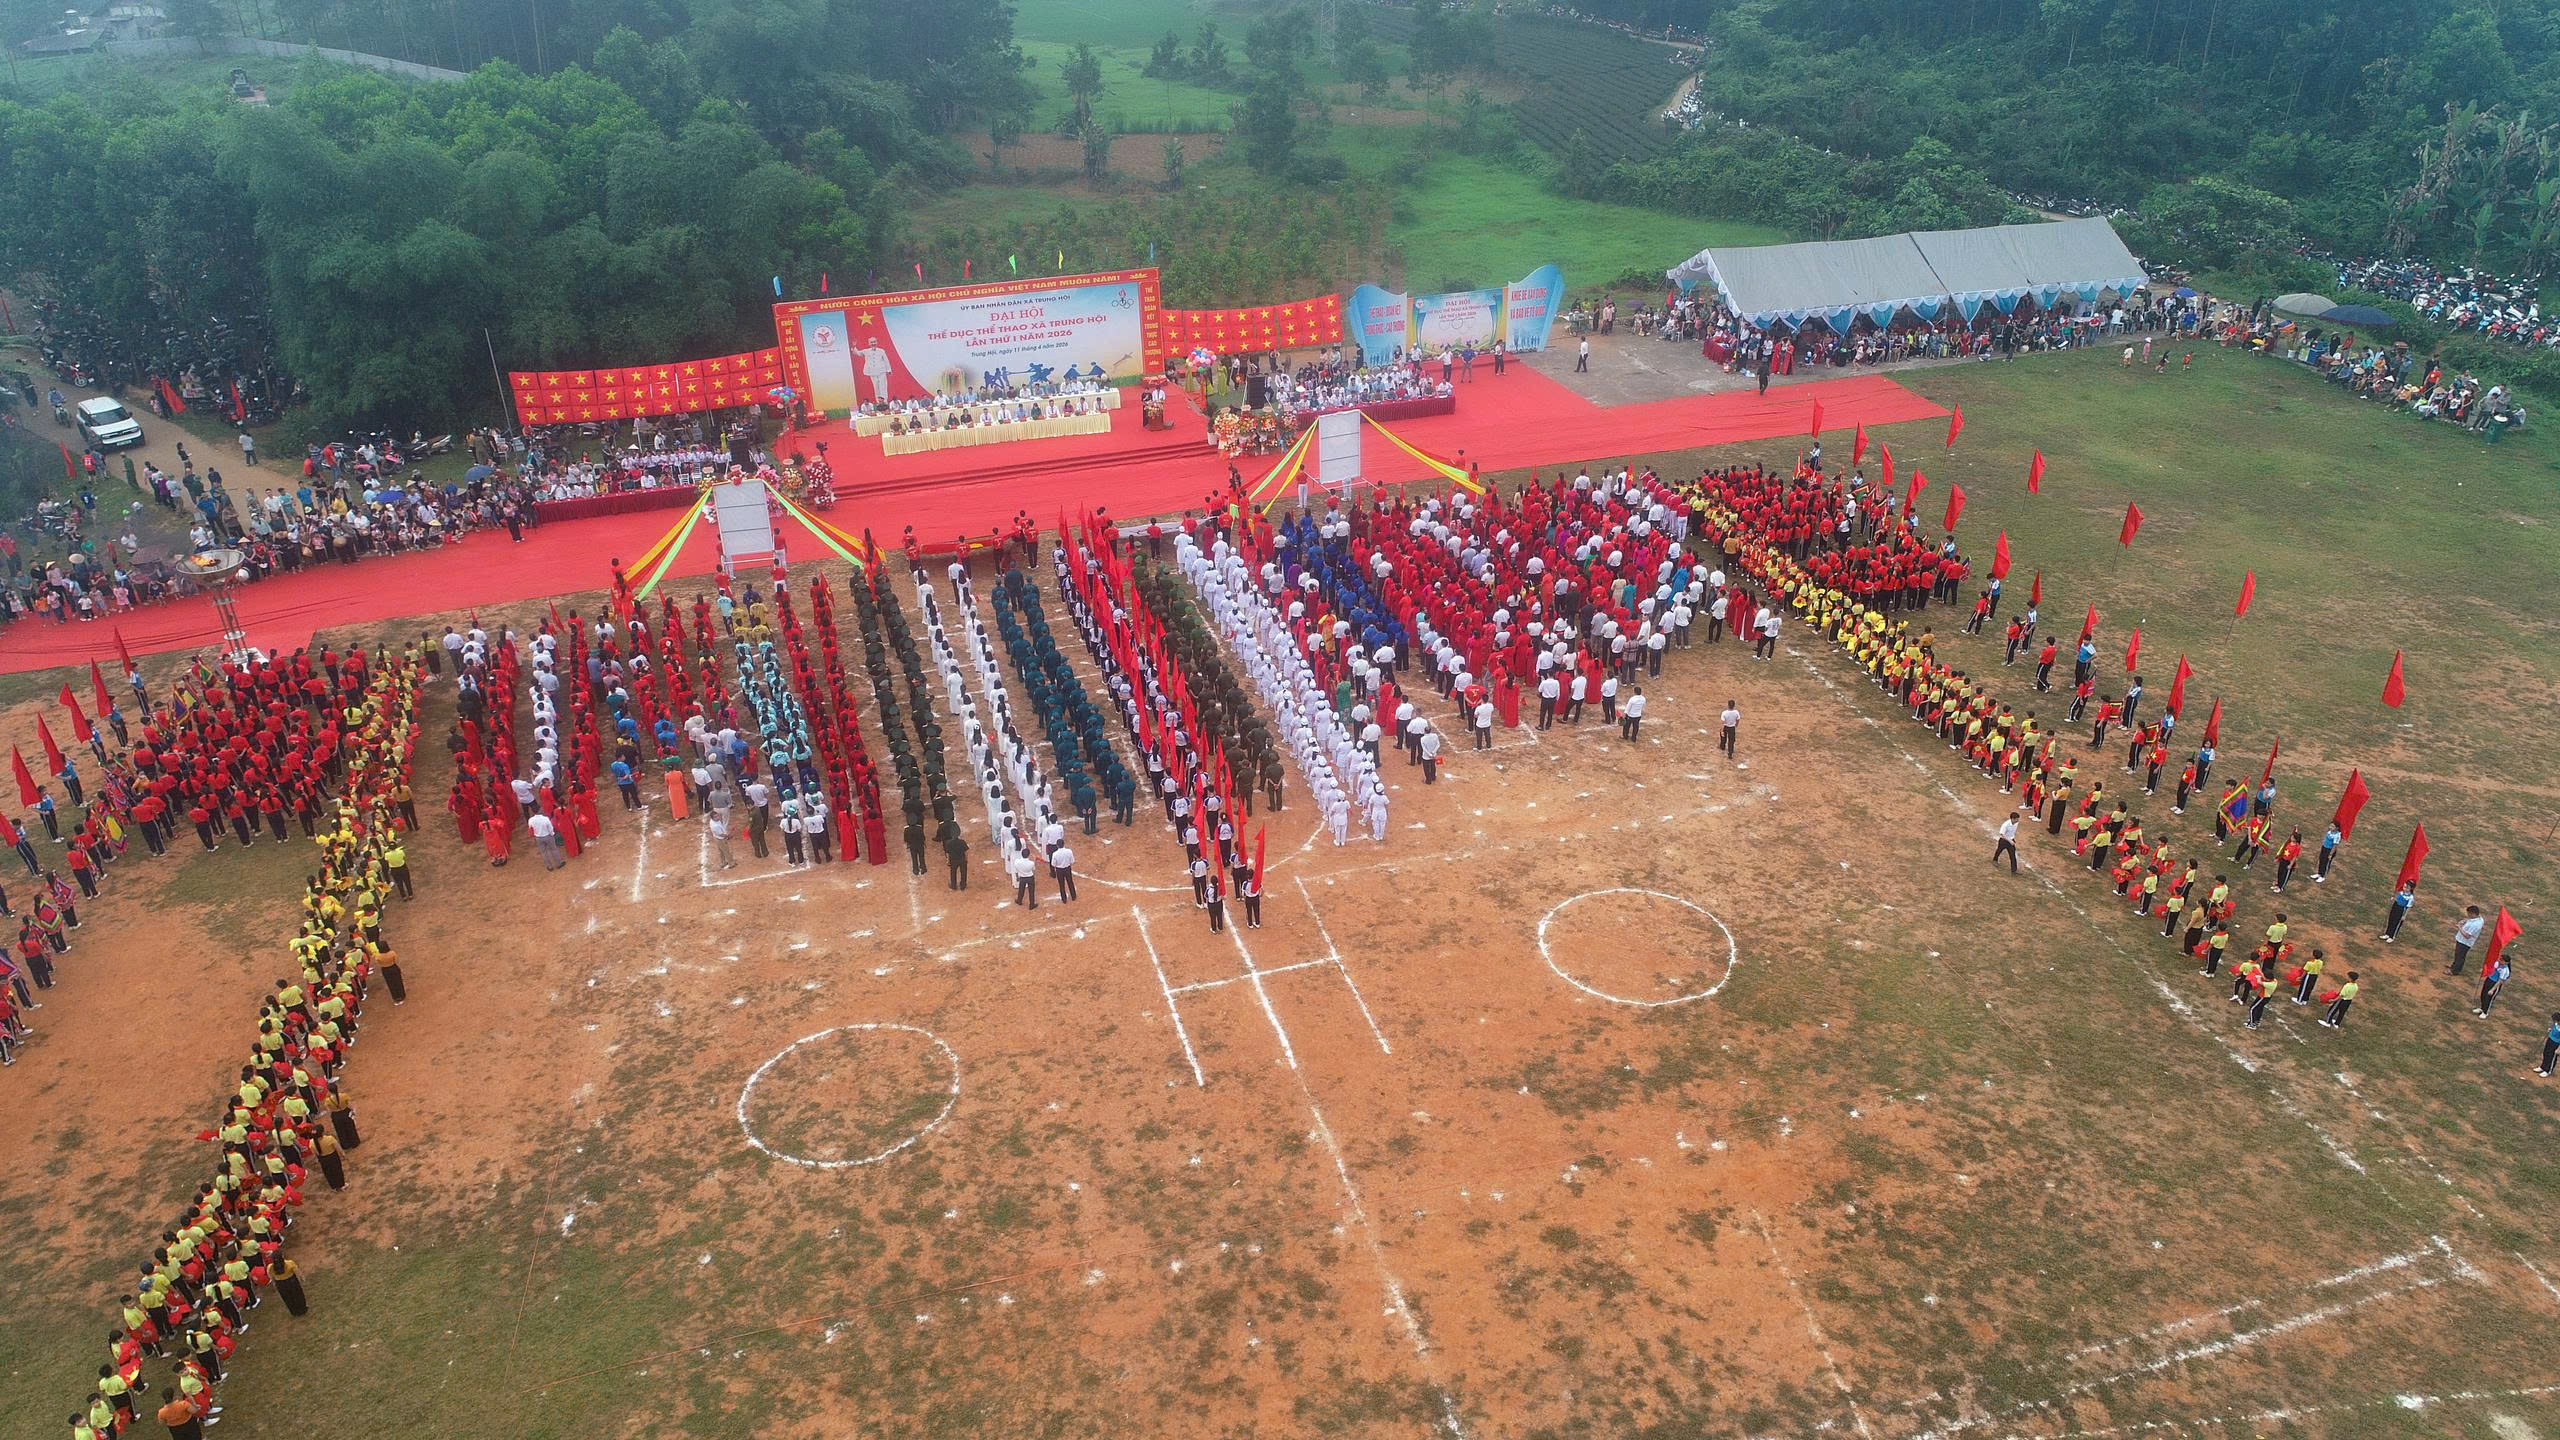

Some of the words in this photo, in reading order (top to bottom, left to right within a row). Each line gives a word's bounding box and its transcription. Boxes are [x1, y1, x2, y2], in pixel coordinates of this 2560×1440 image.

[820, 300, 850, 309] NƯỚC
[853, 298, 884, 307] CỘNG
[928, 292, 946, 300] HỘI
[949, 289, 970, 298] CHỦ
[973, 286, 1005, 295] NGHĨA
[1093, 275, 1120, 283] NĂM!
[990, 311, 1014, 322] ĐẠI
[1020, 306, 1044, 319] HỘI
[928, 330, 947, 340] THỂ
[950, 329, 974, 338] DỤC
[977, 324, 995, 335] THỂ
[998, 324, 1028, 332] THAO
[1031, 320, 1046, 329] XÃ
[1050, 318, 1084, 327] TRUNG
[1088, 314, 1107, 324] HỘI
[966, 336, 986, 347] LẦN
[990, 334, 1010, 344] THỨ
[1020, 331, 1044, 342] NĂM
[1047, 330, 1072, 338] 2026
